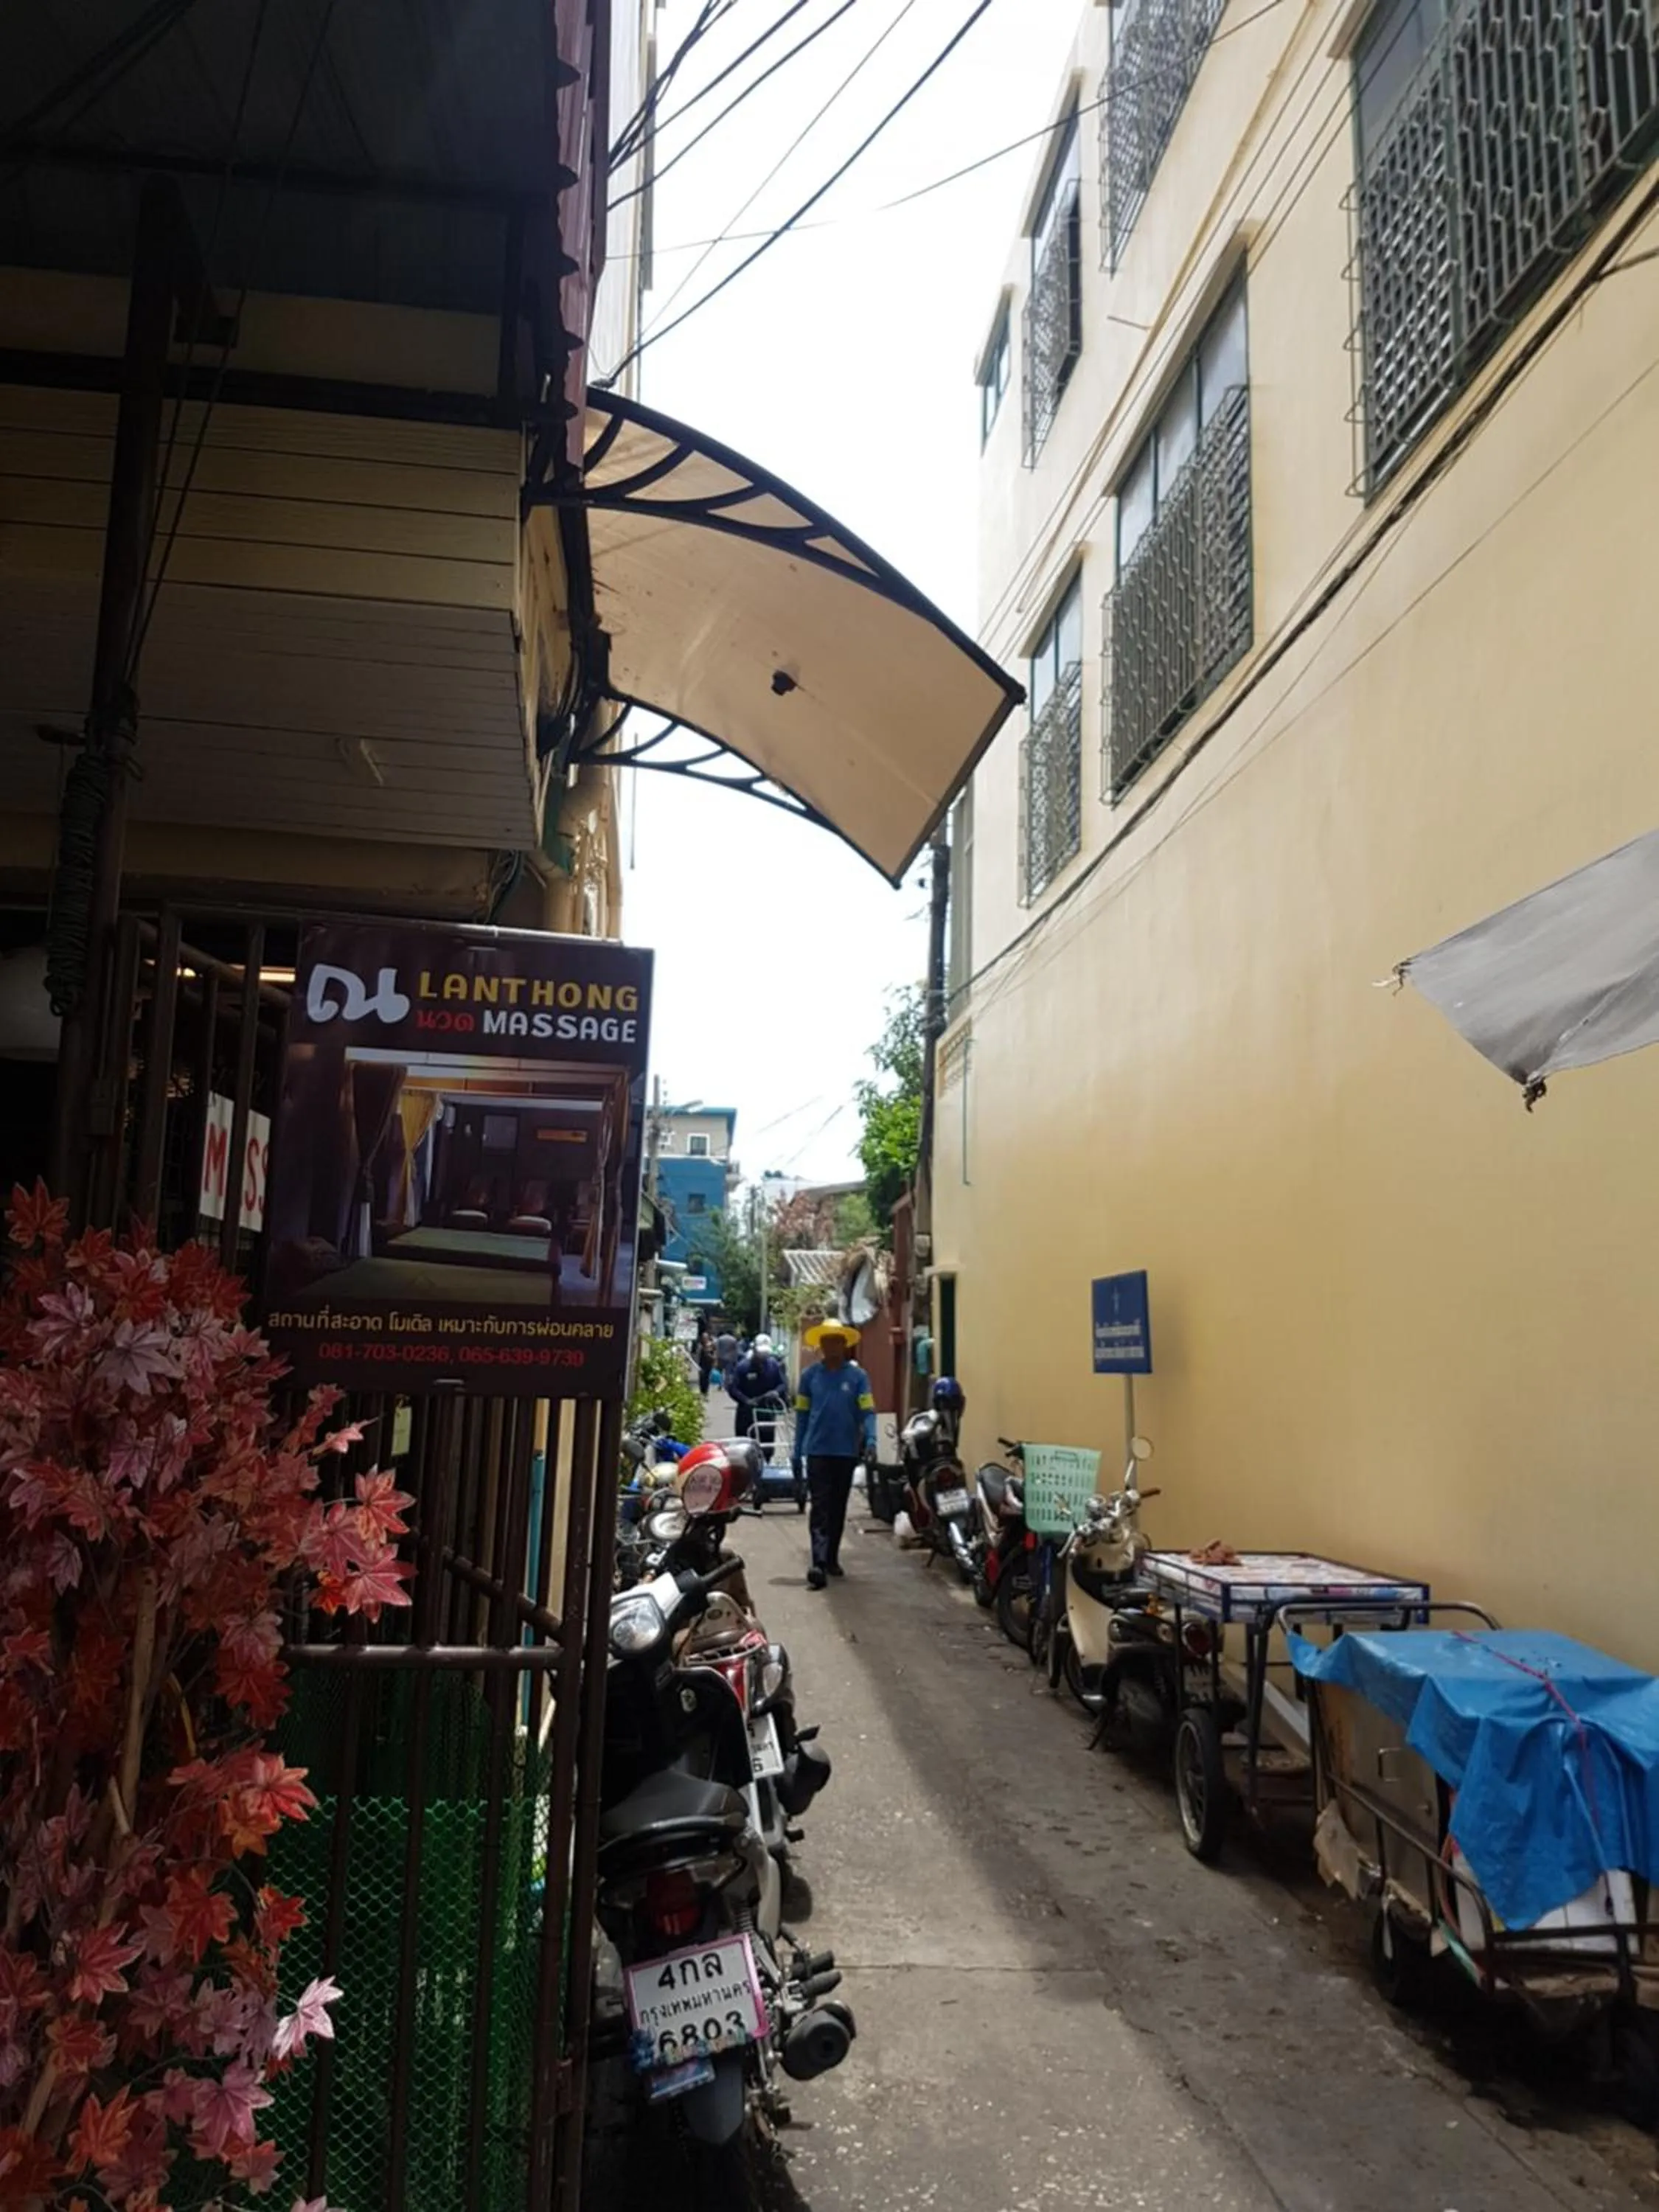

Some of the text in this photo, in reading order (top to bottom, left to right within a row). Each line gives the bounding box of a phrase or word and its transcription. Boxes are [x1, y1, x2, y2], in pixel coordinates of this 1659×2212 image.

[419, 971, 639, 1012] LANTHONG
[416, 1011, 476, 1032] นวด
[482, 1009, 637, 1043] MASSAGE
[657, 1951, 723, 1991] 4กล
[639, 1979, 754, 2026] กรุงเทพมหานคร
[658, 2010, 745, 2054] 6803
